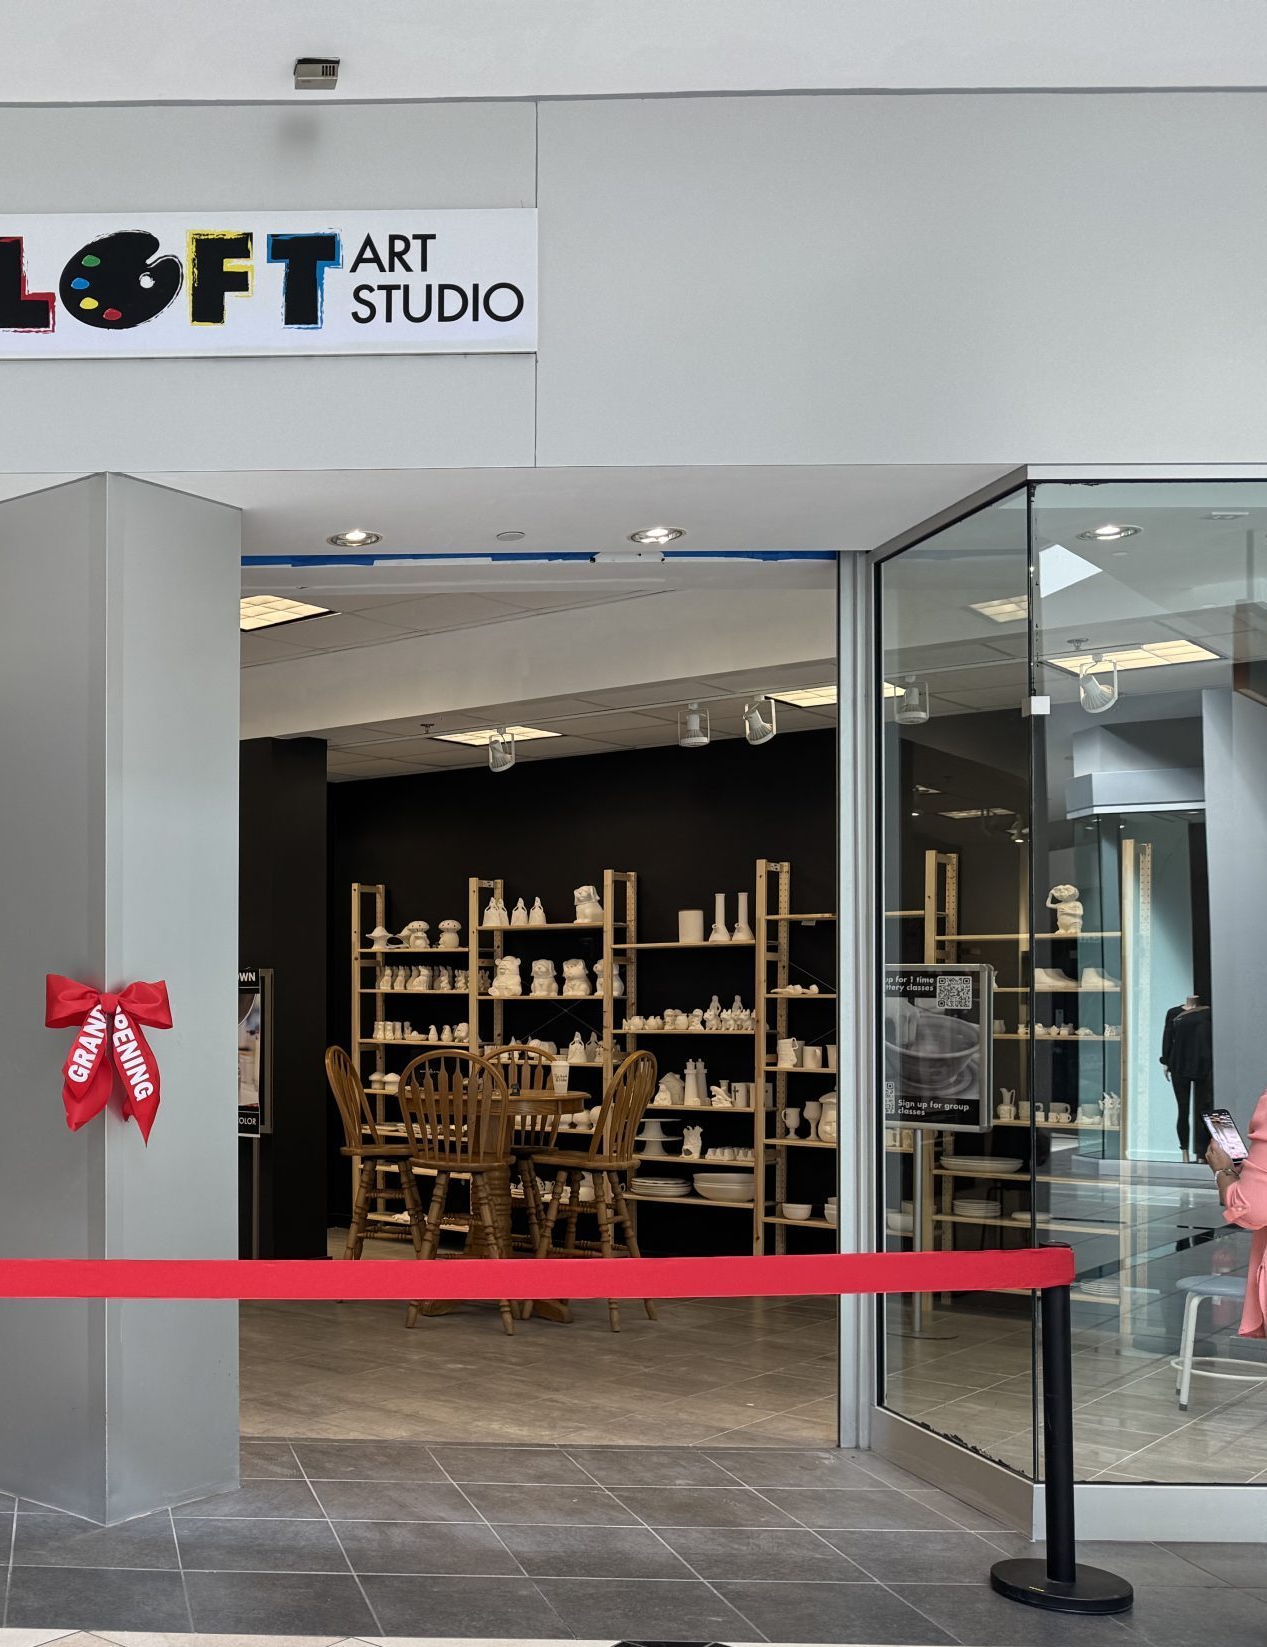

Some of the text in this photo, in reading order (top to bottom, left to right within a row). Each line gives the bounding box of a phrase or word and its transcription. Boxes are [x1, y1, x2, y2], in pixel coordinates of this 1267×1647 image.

[349, 232, 437, 273] ART
[350, 282, 525, 324] STUDIO
[238, 971, 256, 982] WN
[916, 976, 935, 984] time
[113, 1004, 154, 1102] PENING
[897, 1099, 970, 1112] Sign up for group
[897, 1107, 926, 1115] classes
